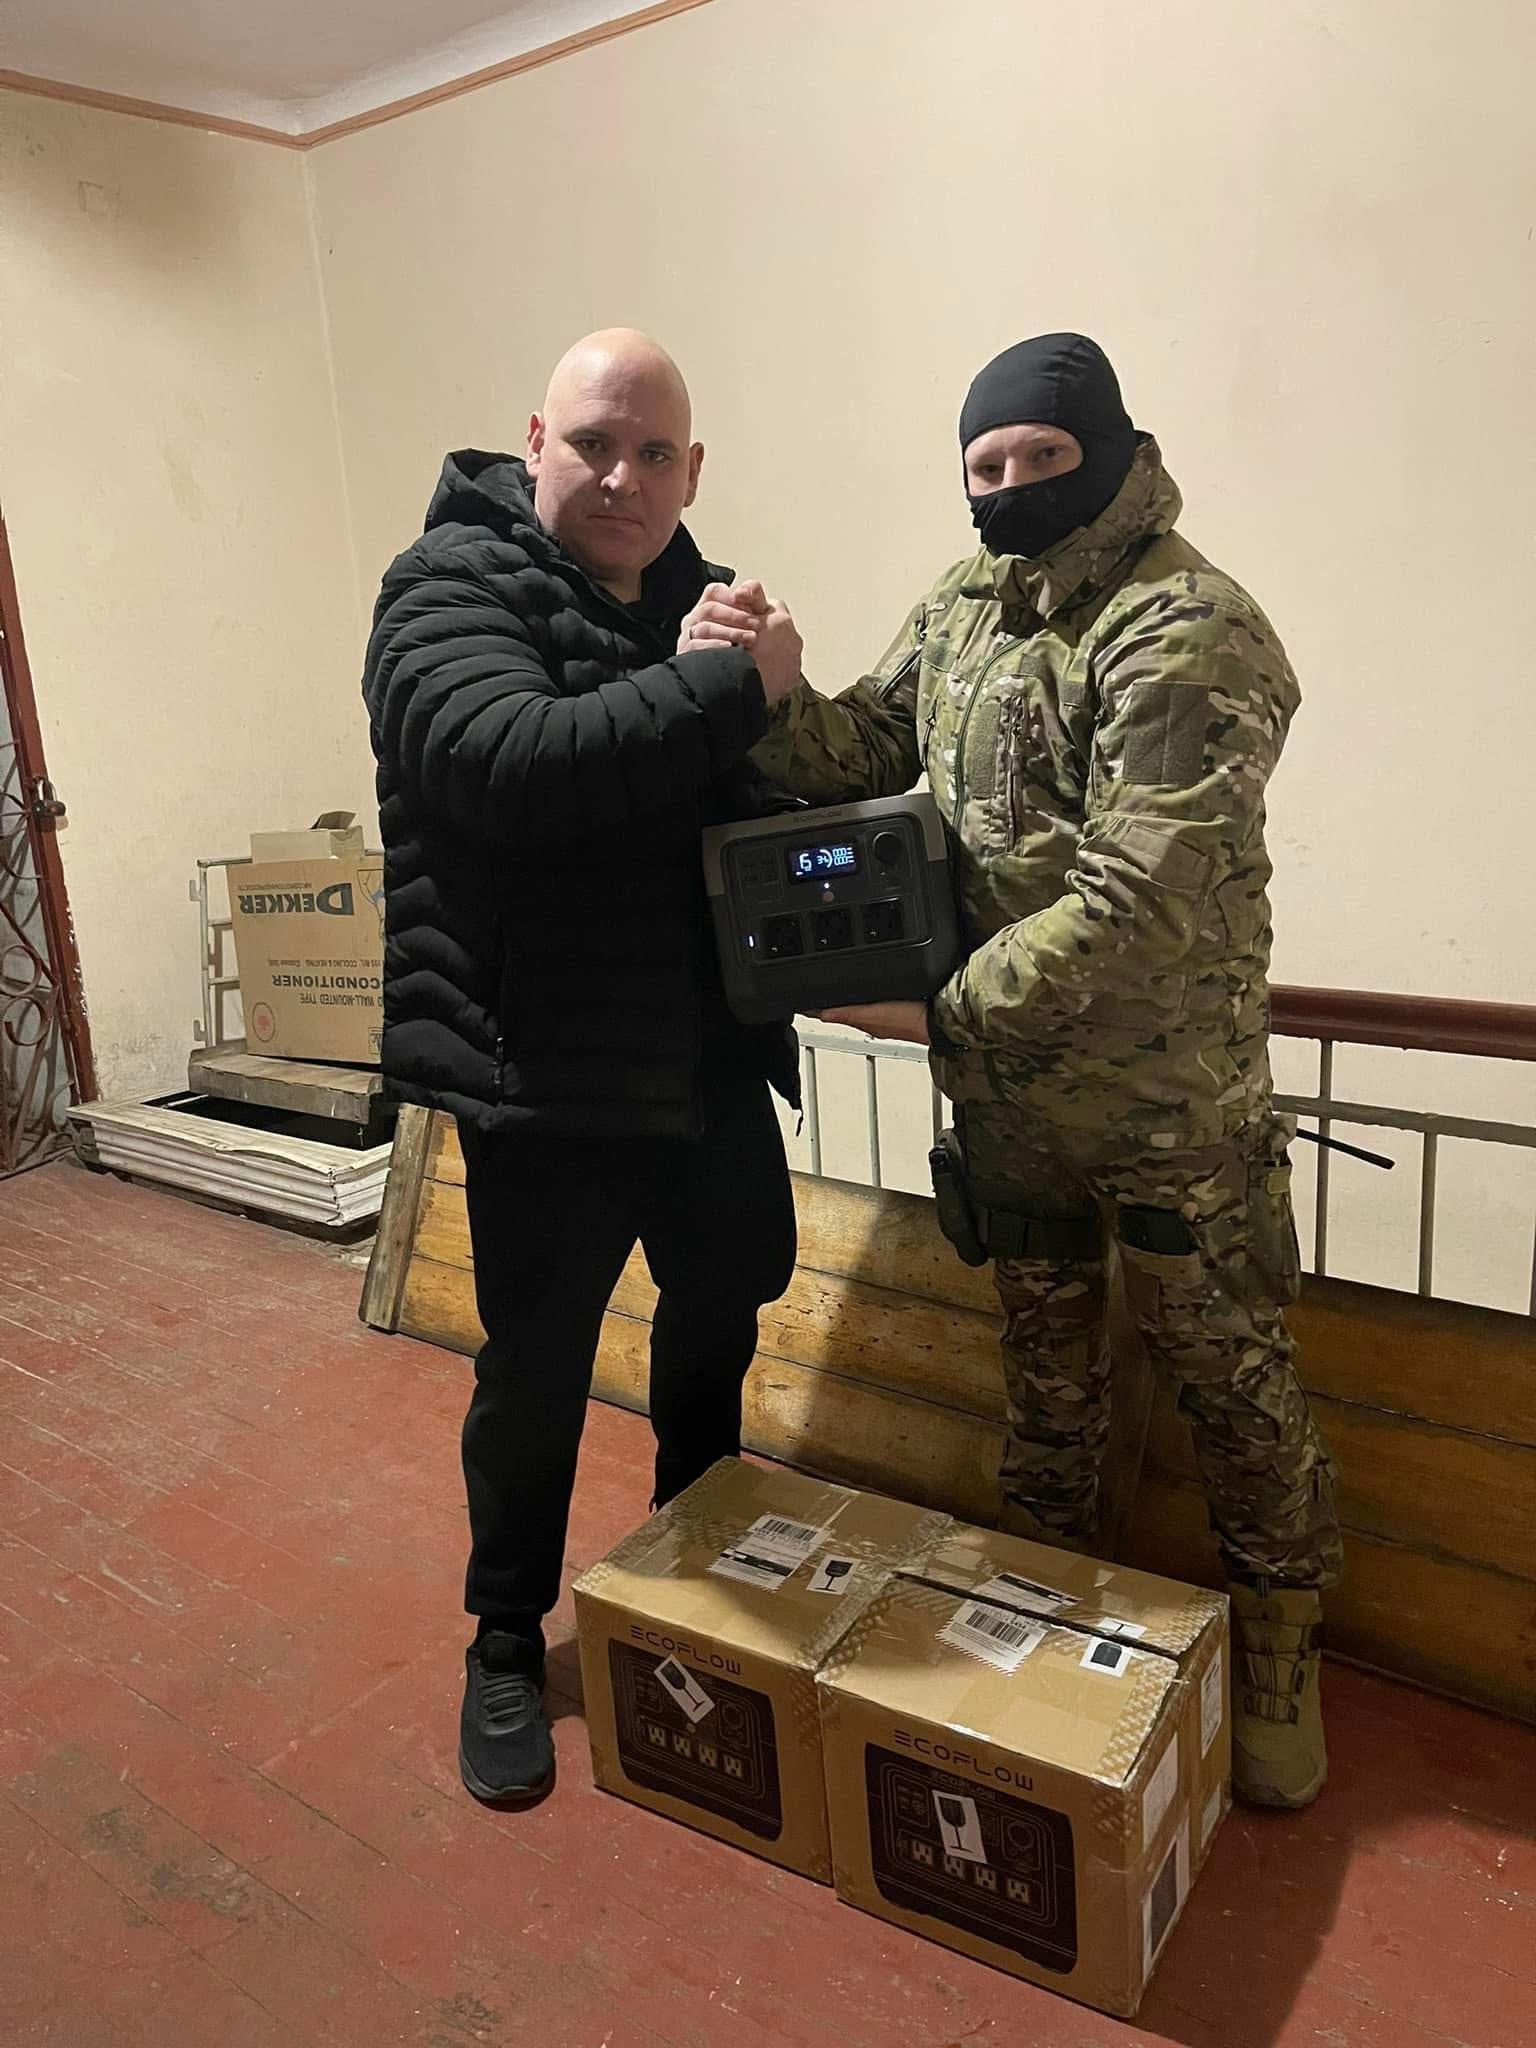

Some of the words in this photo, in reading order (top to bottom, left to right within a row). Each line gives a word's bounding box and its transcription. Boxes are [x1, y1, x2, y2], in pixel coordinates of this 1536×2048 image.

[238, 882, 355, 916] DEKKER
[299, 992, 317, 1005] TYPE
[630, 1624, 741, 1676] ECOFLOW
[894, 1728, 1033, 1792] ECOFLOW
